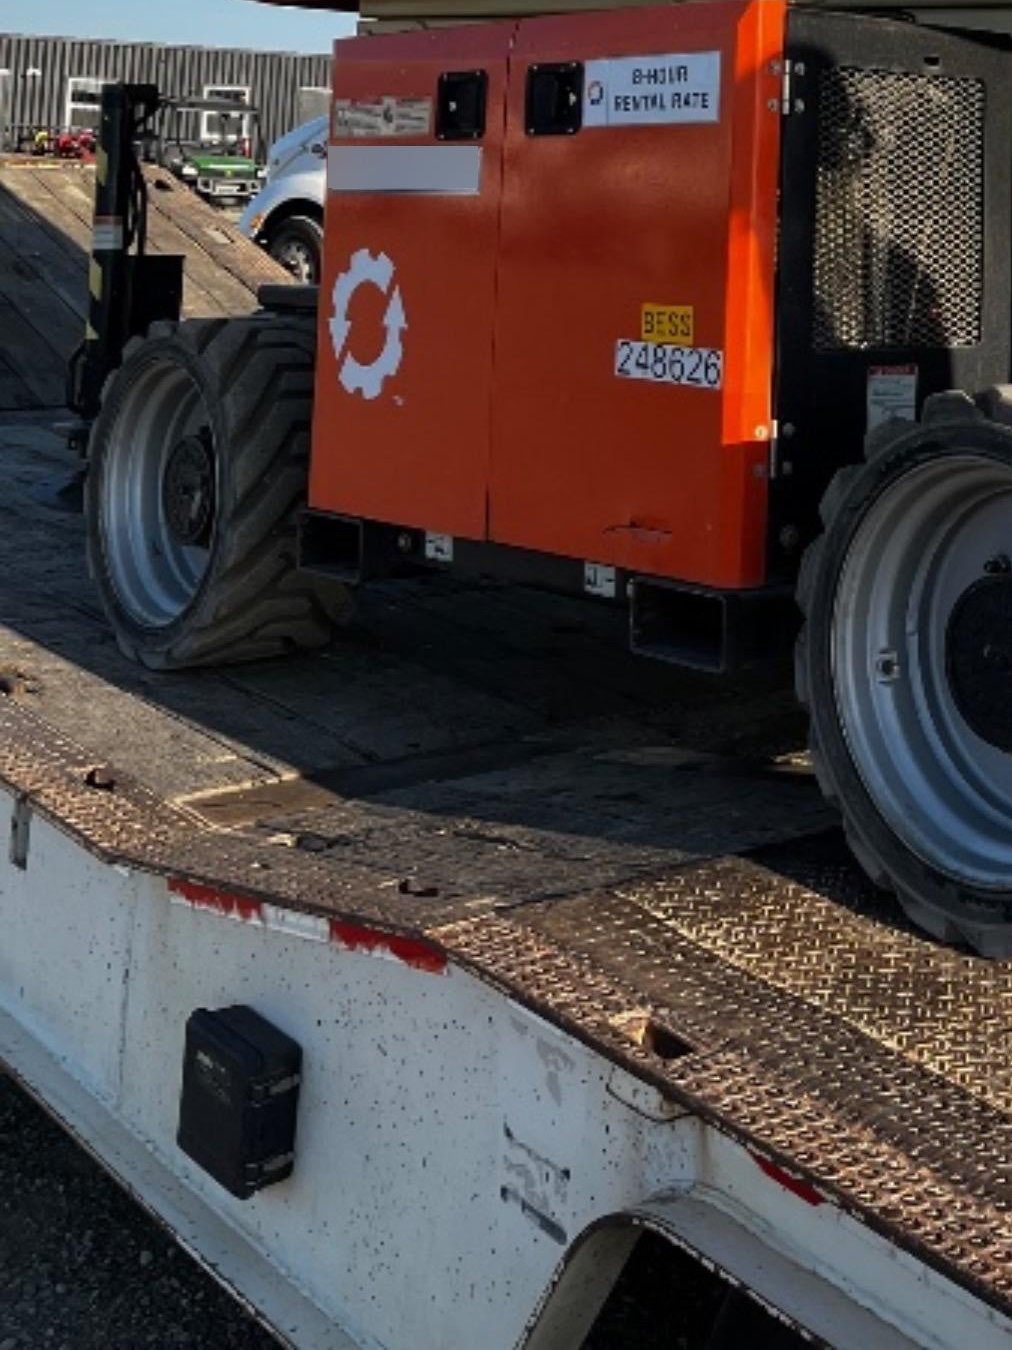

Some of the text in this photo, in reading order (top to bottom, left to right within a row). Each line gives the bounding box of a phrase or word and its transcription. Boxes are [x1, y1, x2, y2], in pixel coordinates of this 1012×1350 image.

[614, 92, 709, 112] RENTAL RATE
[644, 310, 691, 337] BESS
[617, 341, 720, 386] 248626
